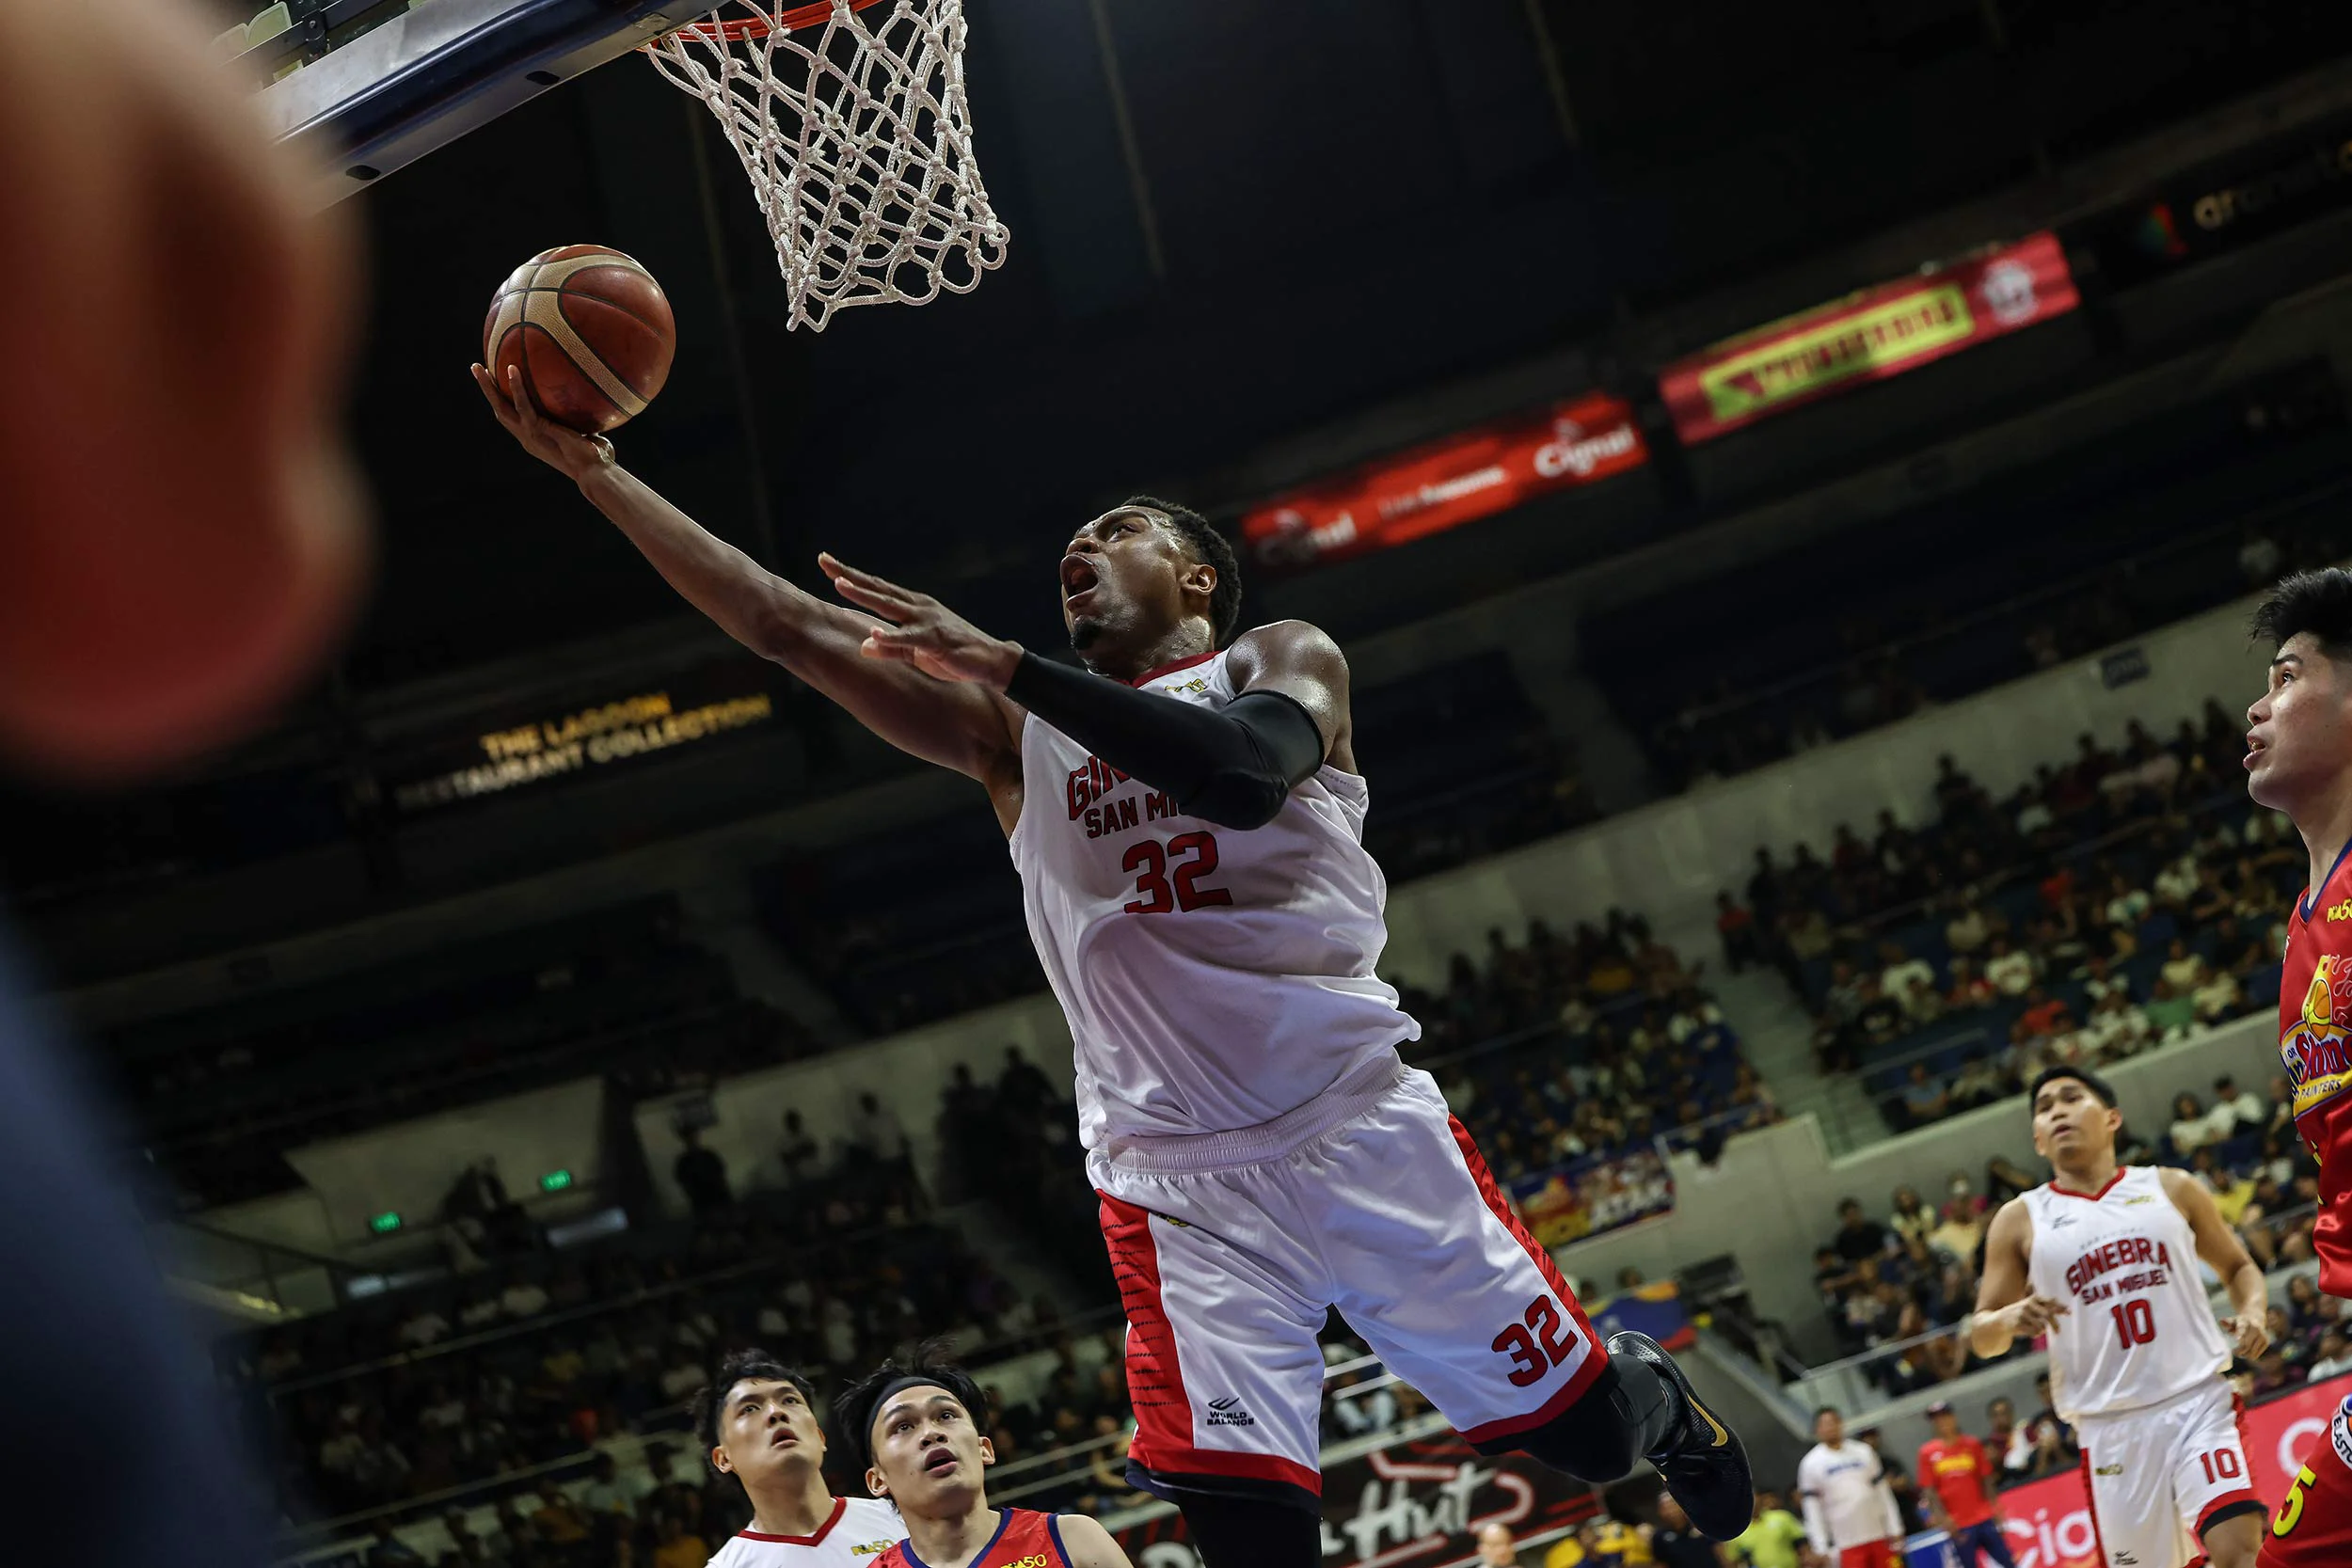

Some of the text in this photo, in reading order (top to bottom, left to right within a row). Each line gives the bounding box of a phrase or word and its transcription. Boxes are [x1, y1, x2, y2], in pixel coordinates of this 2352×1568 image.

[1084, 796, 1139, 839] SAN
[1121, 831, 1233, 914] 32
[2066, 1237, 2172, 1296] GINEBRA
[2081, 1269, 2169, 1306] SAN MIGUEL
[1491, 1294, 1579, 1387] 32
[2111, 1298, 2156, 1350] 10
[1207, 1418, 1254, 1426] BALANCE
[2200, 1448, 2241, 1485] 10
[1342, 1462, 1498, 1560] Hut
[2272, 1464, 2317, 1539] 5
